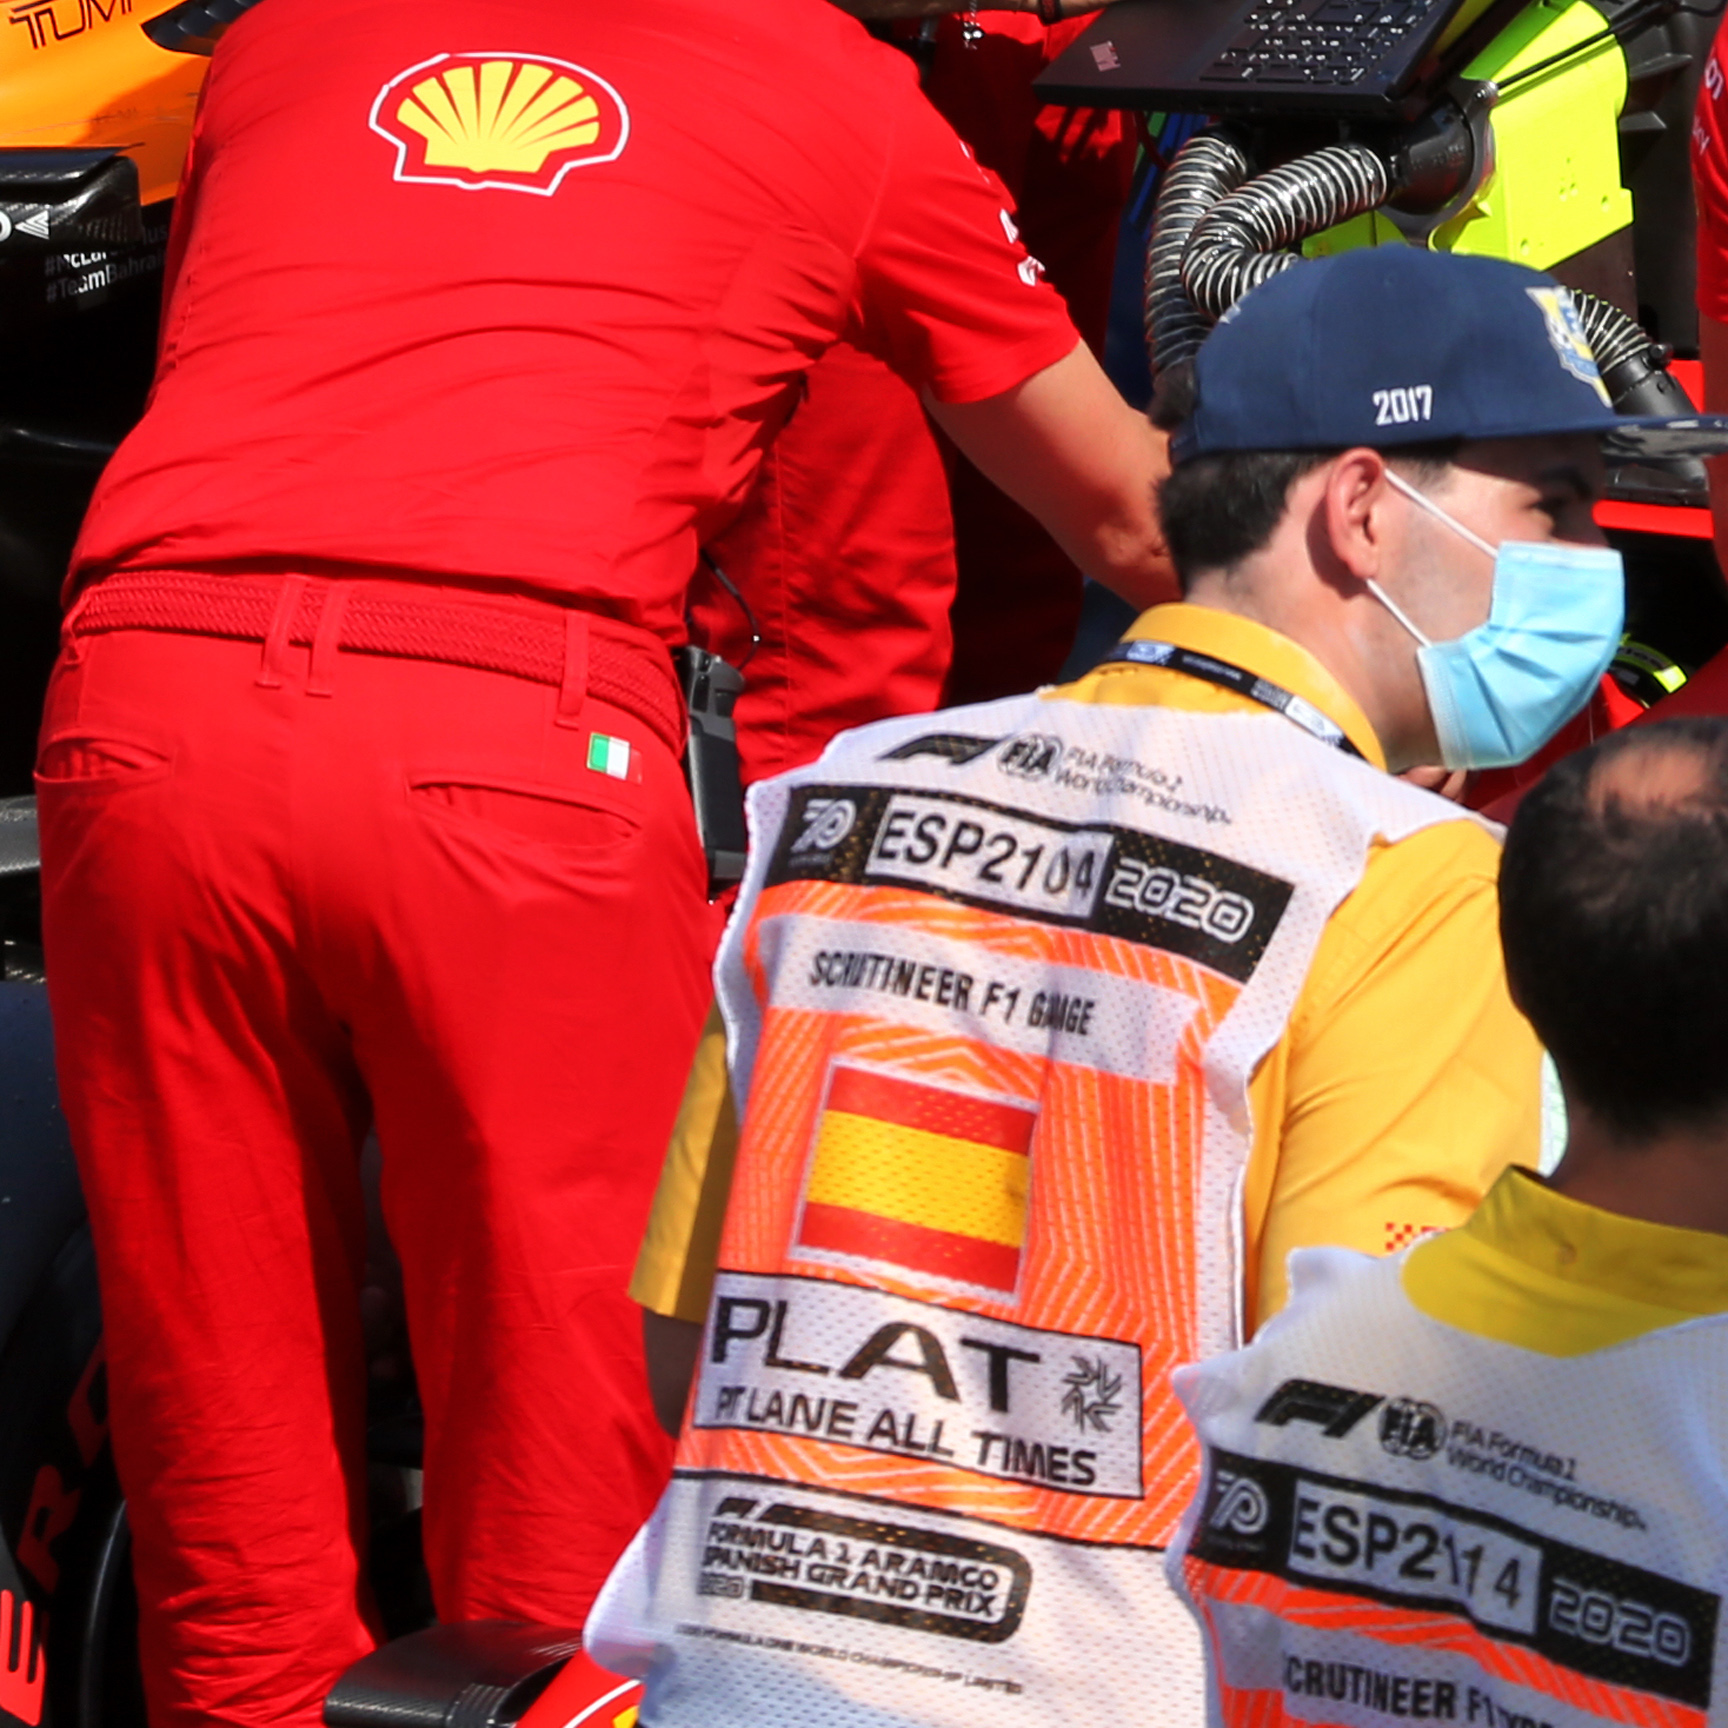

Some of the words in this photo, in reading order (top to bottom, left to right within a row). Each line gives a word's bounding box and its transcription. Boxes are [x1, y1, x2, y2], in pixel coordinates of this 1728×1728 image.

[1372, 385, 1434, 428] 2017
[1105, 857, 1256, 946] 2020
[978, 981, 1022, 1023] F1
[711, 1297, 1042, 1414] PLAT
[746, 1388, 860, 1438] LANE
[866, 1409, 956, 1458] ALL
[972, 1428, 1099, 1488] TIMES
[804, 1563, 920, 1603] GRAND
[923, 1581, 997, 1619] PRIX
[860, 1547, 1000, 1592] ARAMCO
[1548, 1575, 1692, 1668] 2020
